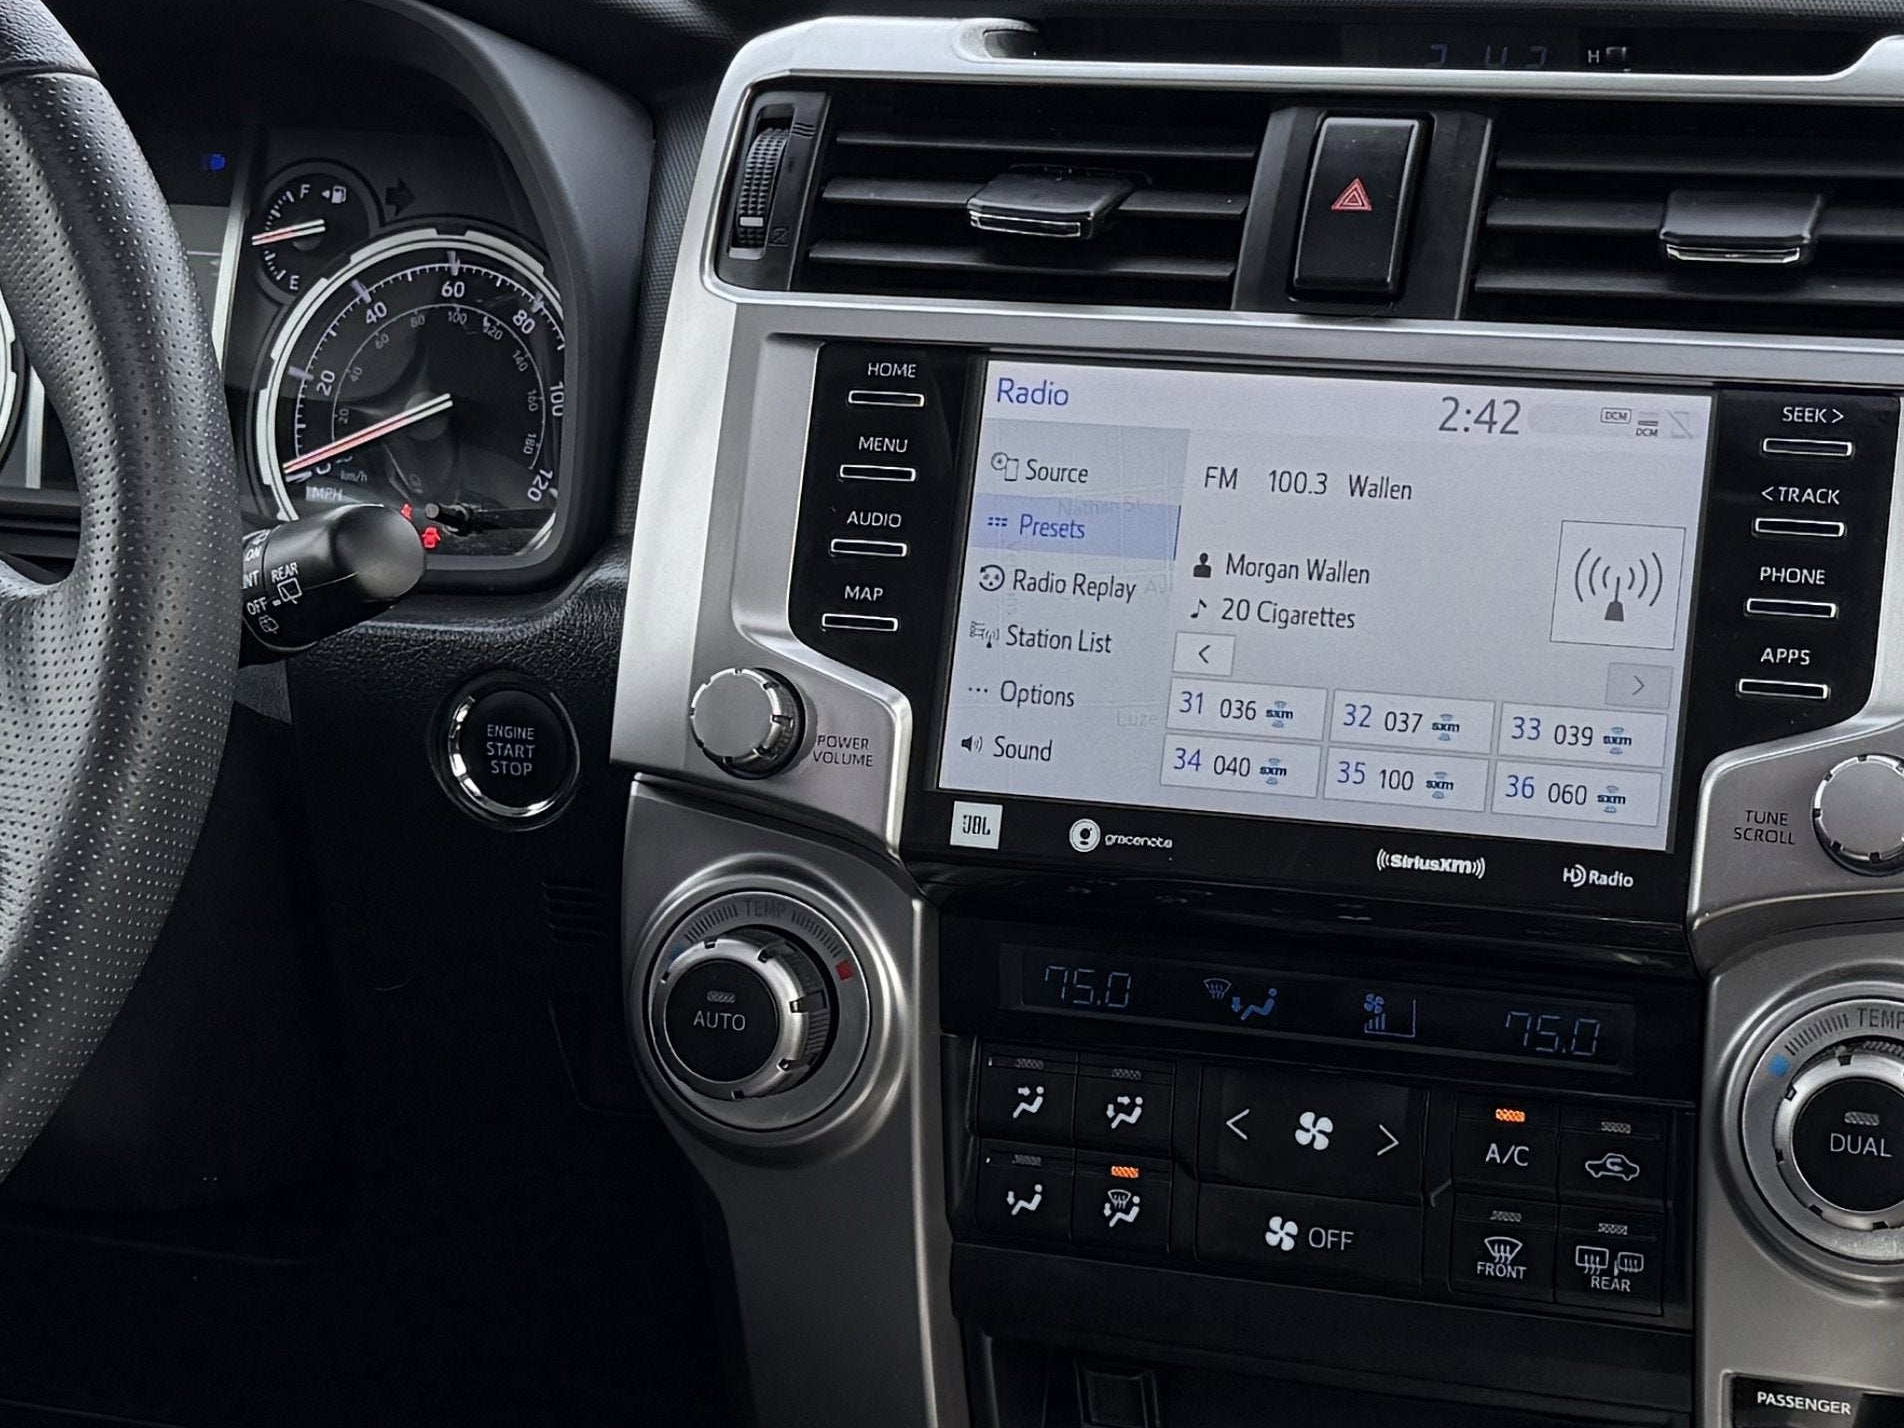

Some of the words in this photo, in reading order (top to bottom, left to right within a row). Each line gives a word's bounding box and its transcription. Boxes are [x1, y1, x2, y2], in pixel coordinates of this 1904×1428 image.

[299, 183, 311, 199] F
[289, 275, 300, 291] E
[441, 281, 465, 299] 60
[364, 301, 389, 325] 40
[511, 309, 536, 335] 80
[316, 369, 336, 397] 20
[867, 362, 917, 379] HOME
[548, 381, 565, 418] 100
[996, 377, 1069, 407] Radio
[1437, 395, 1522, 436] 2:42
[858, 436, 909, 454] MENU
[1635, 427, 1659, 438] DCM
[1024, 458, 1089, 484] Source
[1203, 466, 1239, 490] FM
[1267, 469, 1329, 496] 100.3
[1348, 475, 1413, 500] Wallen
[526, 467, 554, 503] 120
[846, 510, 903, 529] AUDIO
[1019, 513, 1086, 540] Presets
[271, 562, 299, 584] REAR
[1225, 552, 1299, 584] Morgan
[1306, 557, 1371, 585] Wallen
[1759, 567, 1826, 586] PHONE
[844, 586, 884, 603] MAP
[1012, 569, 1066, 594] Radio
[1072, 573, 1137, 604] Replay
[246, 596, 269, 616] OFF
[1221, 597, 1251, 621] 20
[1257, 600, 1356, 630] Cigarettes
[1005, 624, 1072, 651] Station
[1078, 628, 1112, 654] List
[1760, 648, 1811, 666] APPS
[999, 679, 1075, 709] Options
[1178, 690, 1205, 715] 31
[1219, 698, 1257, 721] 036
[1342, 703, 1372, 729] 32
[1383, 711, 1423, 734] 037
[1511, 715, 1541, 742] 33
[1553, 724, 1594, 747] 039
[486, 724, 535, 740] ENGINE
[816, 734, 870, 751] POWER
[486, 741, 536, 759] START
[812, 751, 874, 768] VOLUME
[993, 735, 1053, 762] Sound
[490, 759, 533, 777] STOP
[1173, 747, 1202, 773] 34
[1213, 755, 1252, 778] 040
[1337, 760, 1366, 785] 35
[1378, 768, 1415, 792] 100
[1505, 774, 1535, 799] 36
[1548, 782, 1587, 806] 060
[962, 814, 992, 837] JBL
[1744, 809, 1789, 827] TUNE
[1733, 826, 1796, 846] SCROLL
[1589, 870, 1634, 889] Radio
[744, 900, 787, 919] TEMP
[1044, 965, 1132, 1008] 75.0
[693, 1010, 746, 1032] AUTO
[1505, 1011, 1601, 1056] 75.0
[1485, 1142, 1530, 1167] A/C
[1829, 1133, 1893, 1159] DUAL
[1308, 1226, 1355, 1251] OFF
[1476, 1261, 1528, 1280] FRONT
[1590, 1275, 1631, 1293] REAR
[1756, 1391, 1852, 1416] PASSENGER
